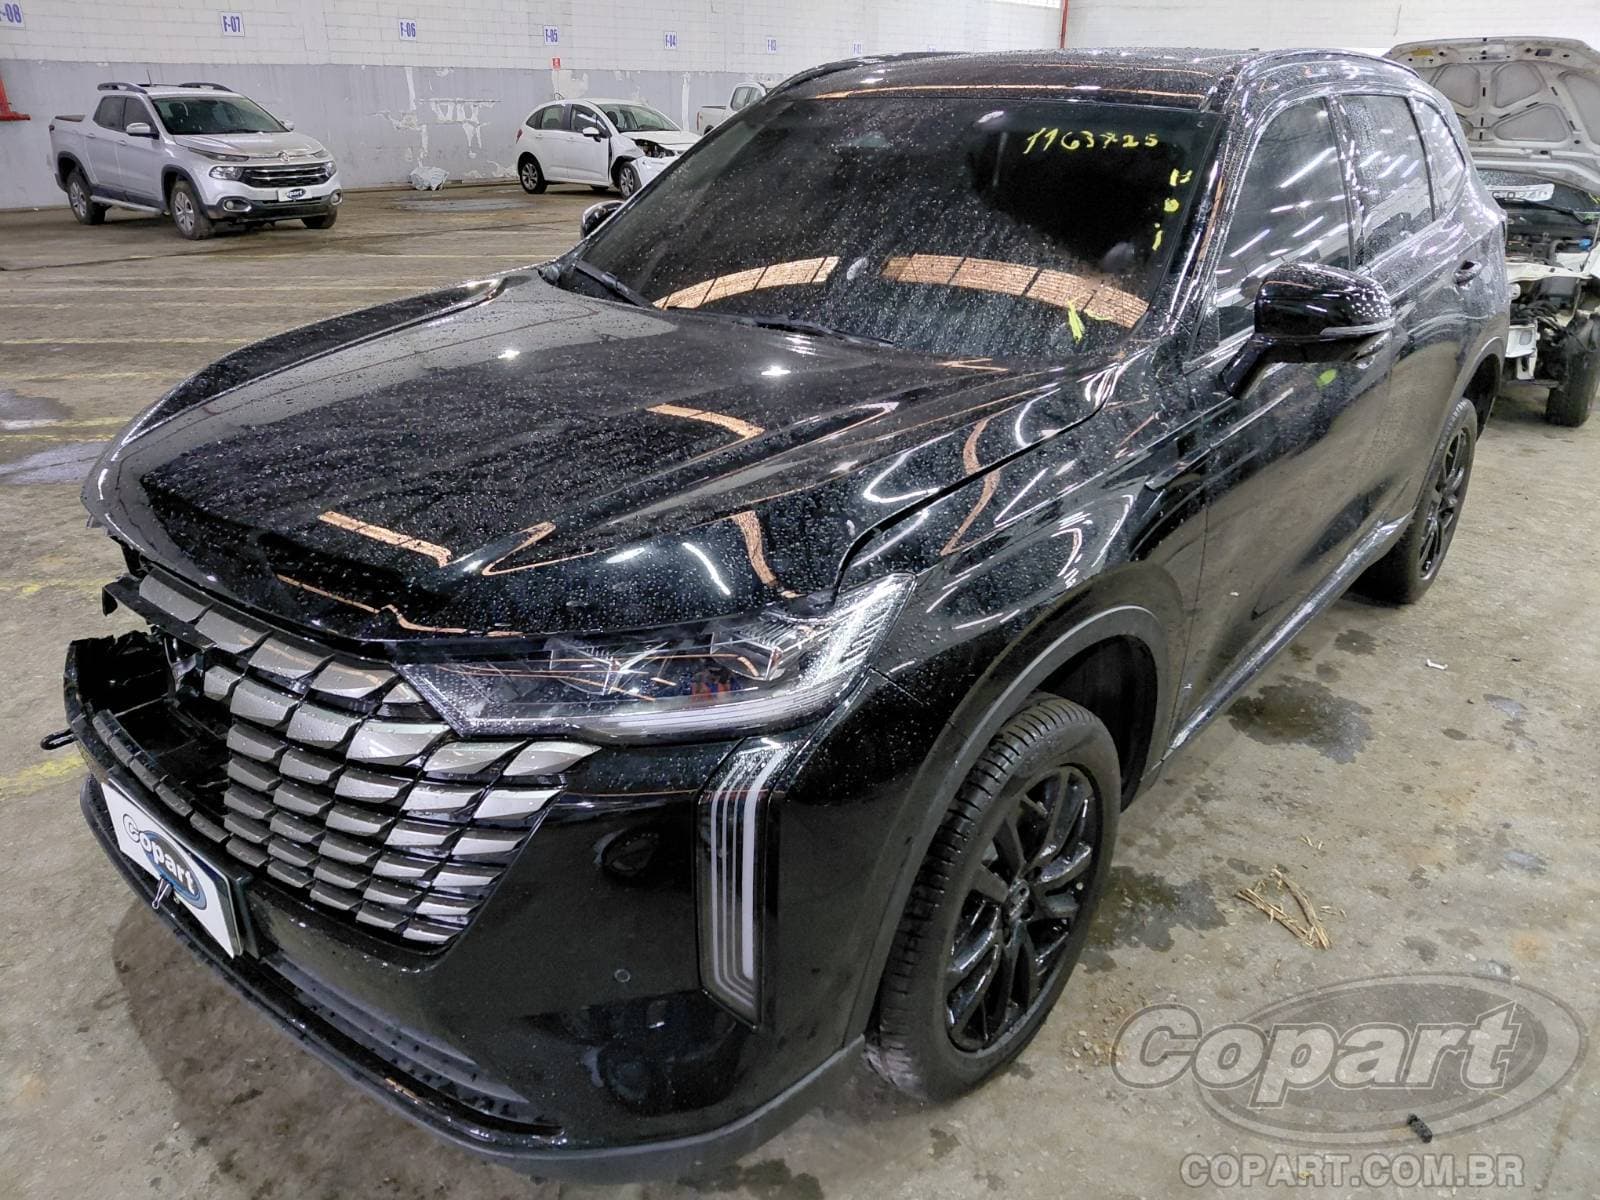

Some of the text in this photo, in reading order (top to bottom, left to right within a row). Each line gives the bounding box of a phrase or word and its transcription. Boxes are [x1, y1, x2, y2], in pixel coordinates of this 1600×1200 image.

[0, 3, 22, 23] -08
[222, 15, 241, 33] F-07
[400, 21, 416, 37] F-06
[122, 812, 198, 895] Copart
